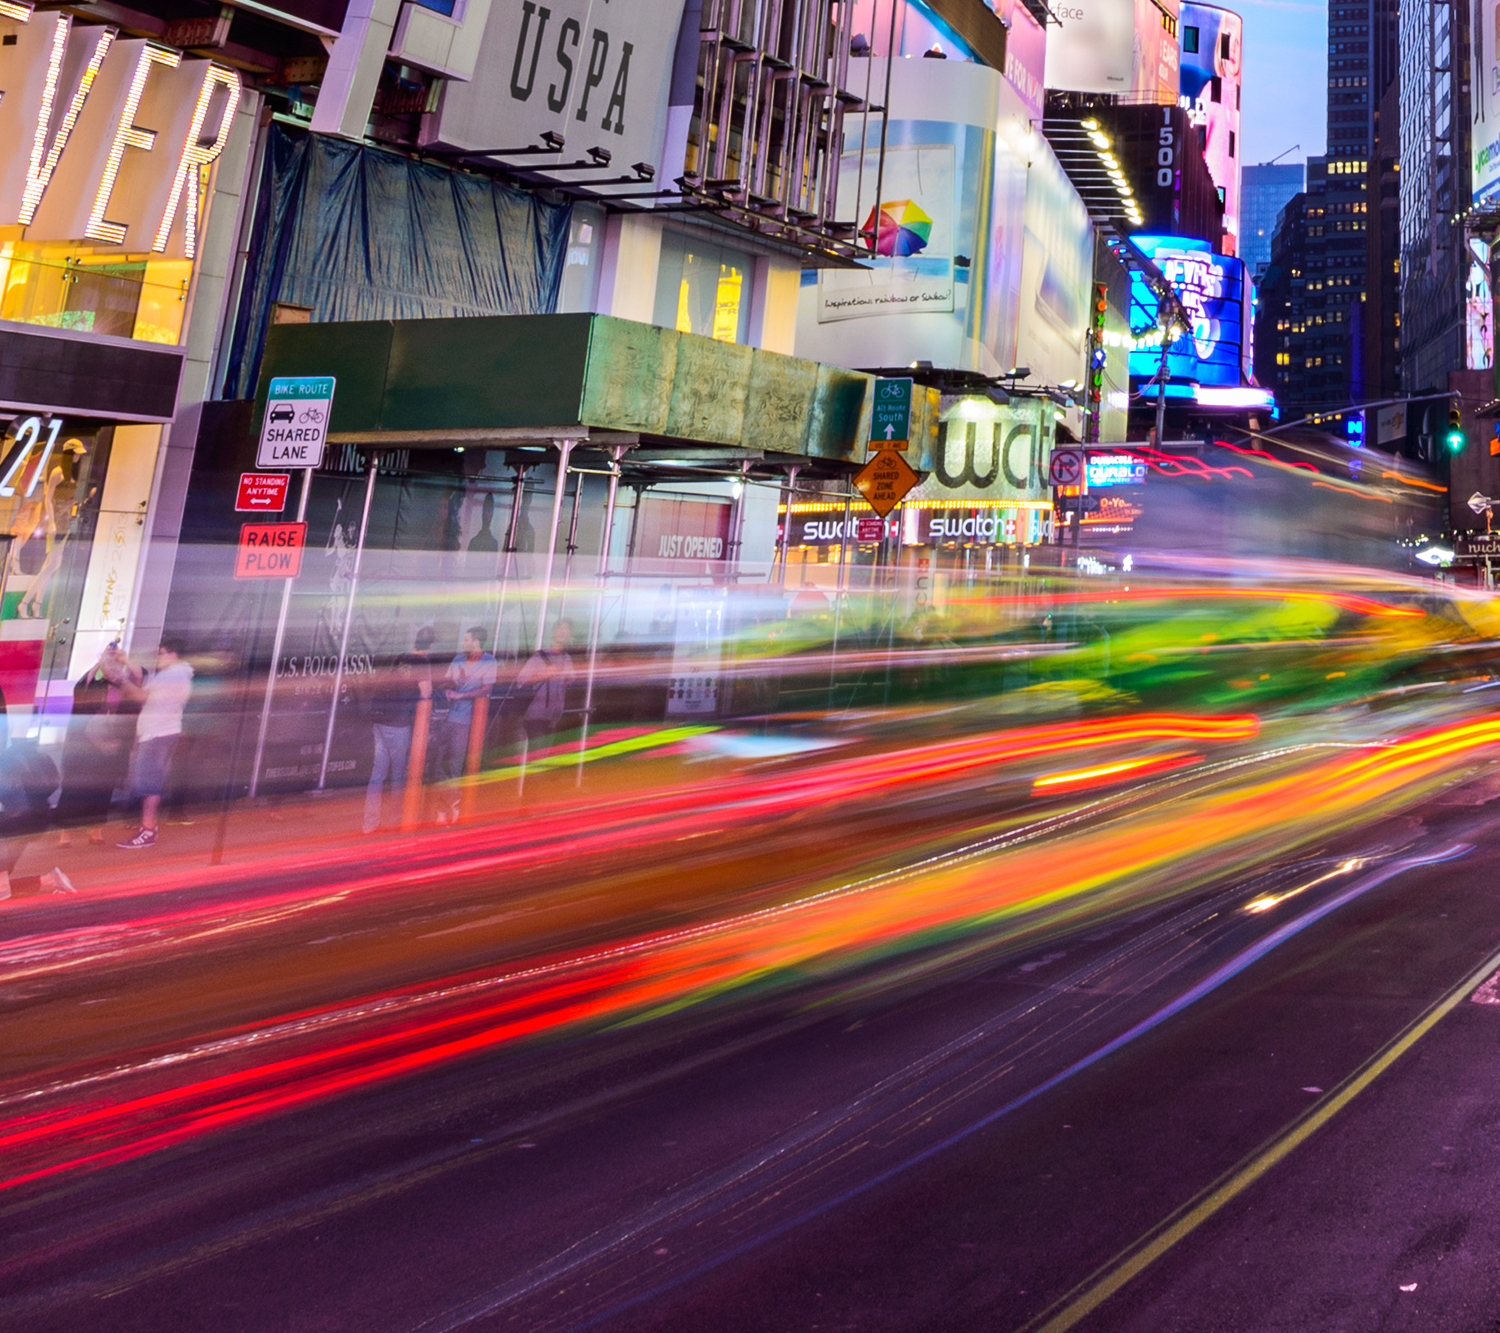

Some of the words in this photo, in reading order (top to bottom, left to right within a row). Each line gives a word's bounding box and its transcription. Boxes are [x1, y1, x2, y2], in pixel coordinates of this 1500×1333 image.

[509, 0, 633, 134] USPA
[1158, 108, 1175, 187] 1500
[909, 295, 920, 303] or
[275, 384, 295, 395] BIKE
[298, 383, 328, 394] ROUTE
[878, 413, 903, 422] South
[267, 428, 320, 442] SHARED
[272, 446, 308, 460] LANE
[243, 478, 253, 486] NO
[255, 477, 285, 486] STANDING
[873, 472, 899, 481] SHARED
[246, 487, 279, 496] ANYTIME
[876, 482, 893, 491] ZONE
[873, 492, 896, 500] AHEAD
[929, 515, 1005, 537] swatch
[247, 531, 298, 547] RAISE
[658, 536, 683, 557] JUST
[683, 535, 723, 558] OPENED
[245, 554, 293, 570] PLOW
